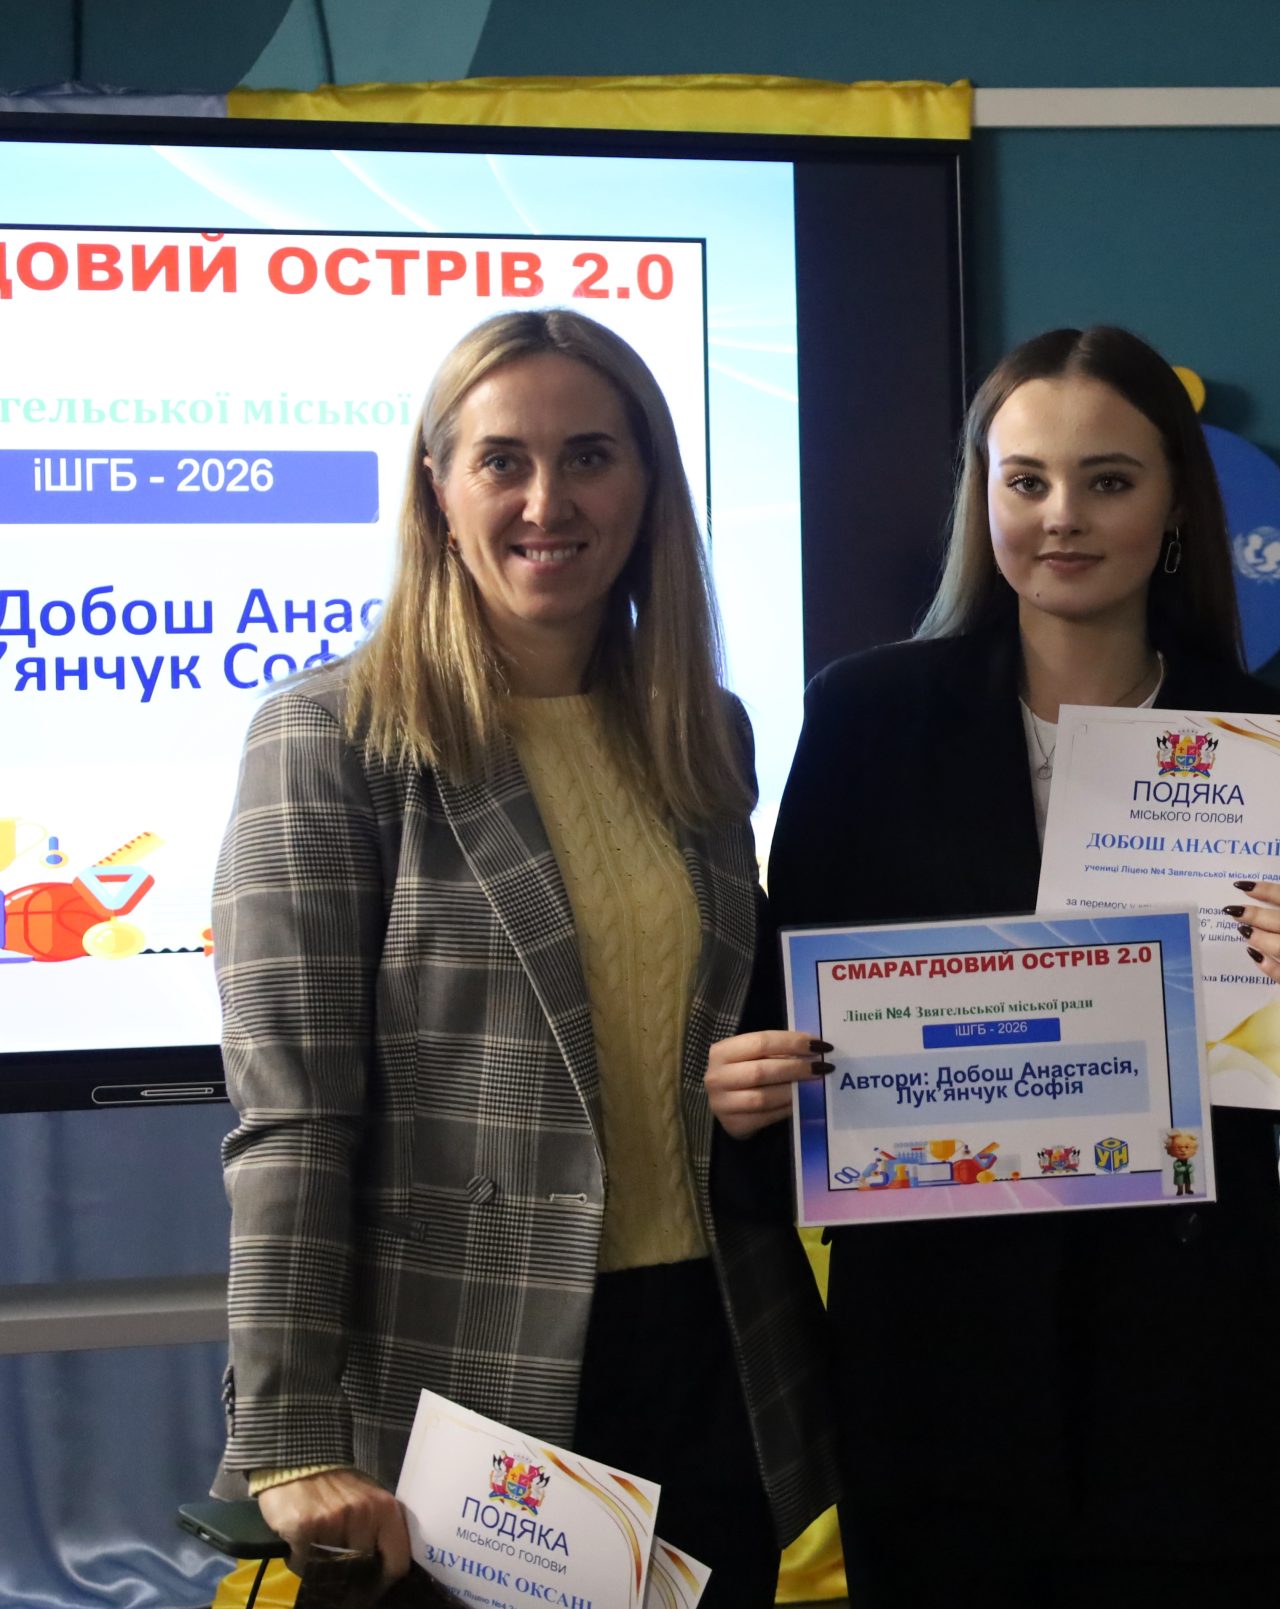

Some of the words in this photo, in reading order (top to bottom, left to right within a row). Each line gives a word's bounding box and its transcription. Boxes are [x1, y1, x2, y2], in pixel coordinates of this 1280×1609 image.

[268, 247, 543, 297] ОСТРІВ
[572, 253, 673, 300] 2.0
[243, 392, 412, 425] міської
[34, 458, 137, 492] іШГБ
[149, 475, 165, 484] -
[176, 458, 275, 492] 2026
[0, 585, 213, 648] Добош
[1132, 780, 1245, 807] ПОДЯКА
[1130, 809, 1191, 823] МІСЬКОГО
[1194, 811, 1243, 824] ГОЛОВИ
[1086, 832, 1165, 851] ДОБОШ
[1084, 864, 1119, 873] учениці
[1121, 865, 1148, 875] Ліцею
[1150, 867, 1166, 875] №4
[1228, 871, 1259, 880] міської
[831, 951, 1015, 981] СМАРАГДОВИЙ
[1022, 949, 1110, 969] ОСТРІВ
[1117, 946, 1152, 965] 2.0
[843, 1008, 882, 1023] Ліцей
[886, 1007, 911, 1020] №4
[916, 1001, 1005, 1018] Звягельської
[1008, 999, 1058, 1013] міської
[1060, 999, 1093, 1013] ради
[955, 1024, 986, 1036] іШГБ
[998, 1021, 1028, 1034] 2026
[840, 1071, 929, 1091] Автори:
[936, 1064, 1013, 1088] Добош
[1020, 1057, 1139, 1081] Анастасія,
[1014, 1077, 1084, 1099] Софія
[461, 1496, 569, 1556] ПОДЯКА
[424, 1544, 511, 1588] ЗДУНЮК
[456, 1527, 515, 1556] МІСЬКОГО
[518, 1549, 567, 1575] ГОЛОВИ
